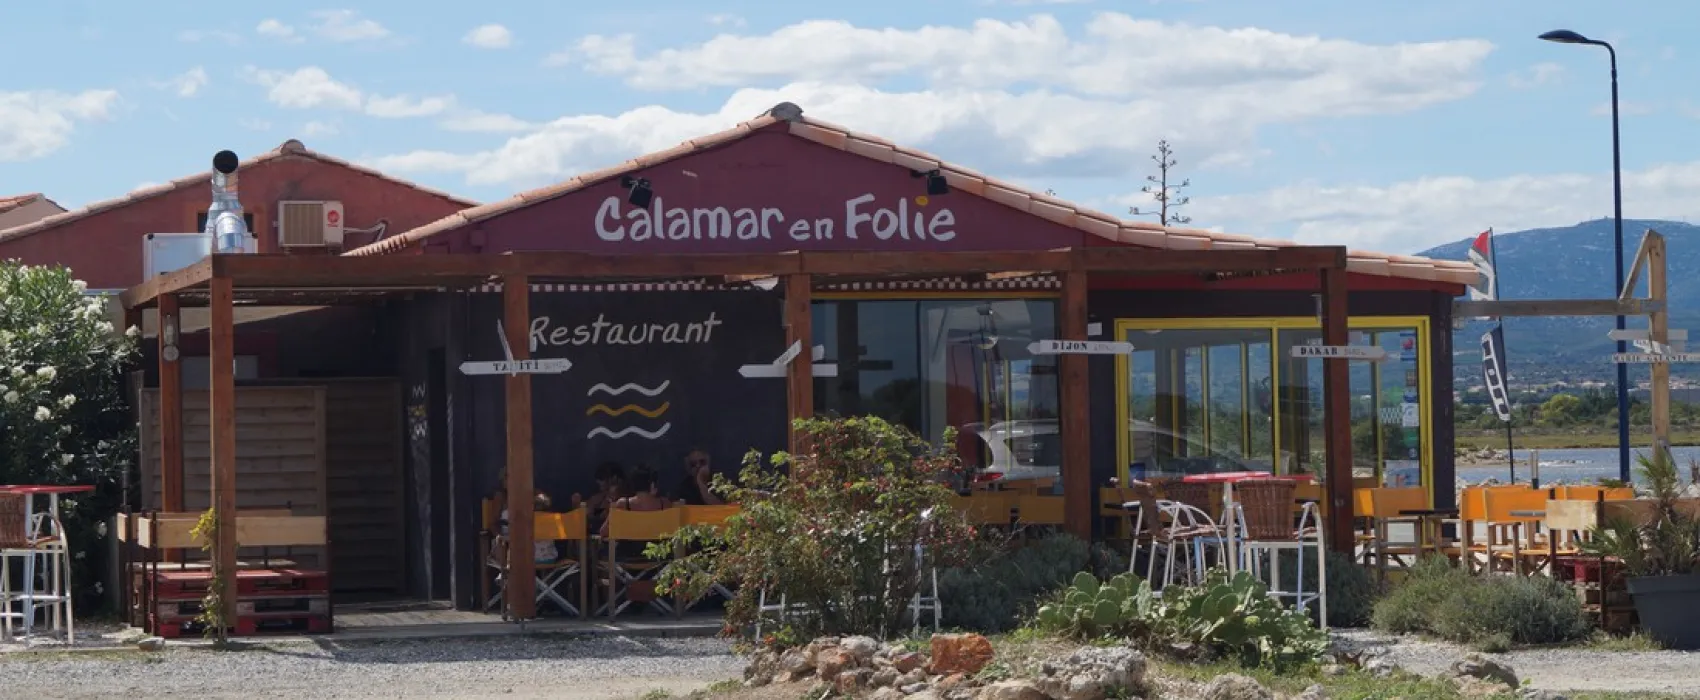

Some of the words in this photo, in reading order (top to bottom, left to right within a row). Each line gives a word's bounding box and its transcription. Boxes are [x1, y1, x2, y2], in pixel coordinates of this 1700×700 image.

[595, 195, 784, 242] Calamar
[789, 218, 833, 240] en
[846, 193, 956, 242] Folie
[529, 311, 723, 346] Restaurant
[1052, 342, 1088, 350] DIJON
[1301, 347, 1338, 355] DAKAR
[493, 360, 539, 371] TAITI
